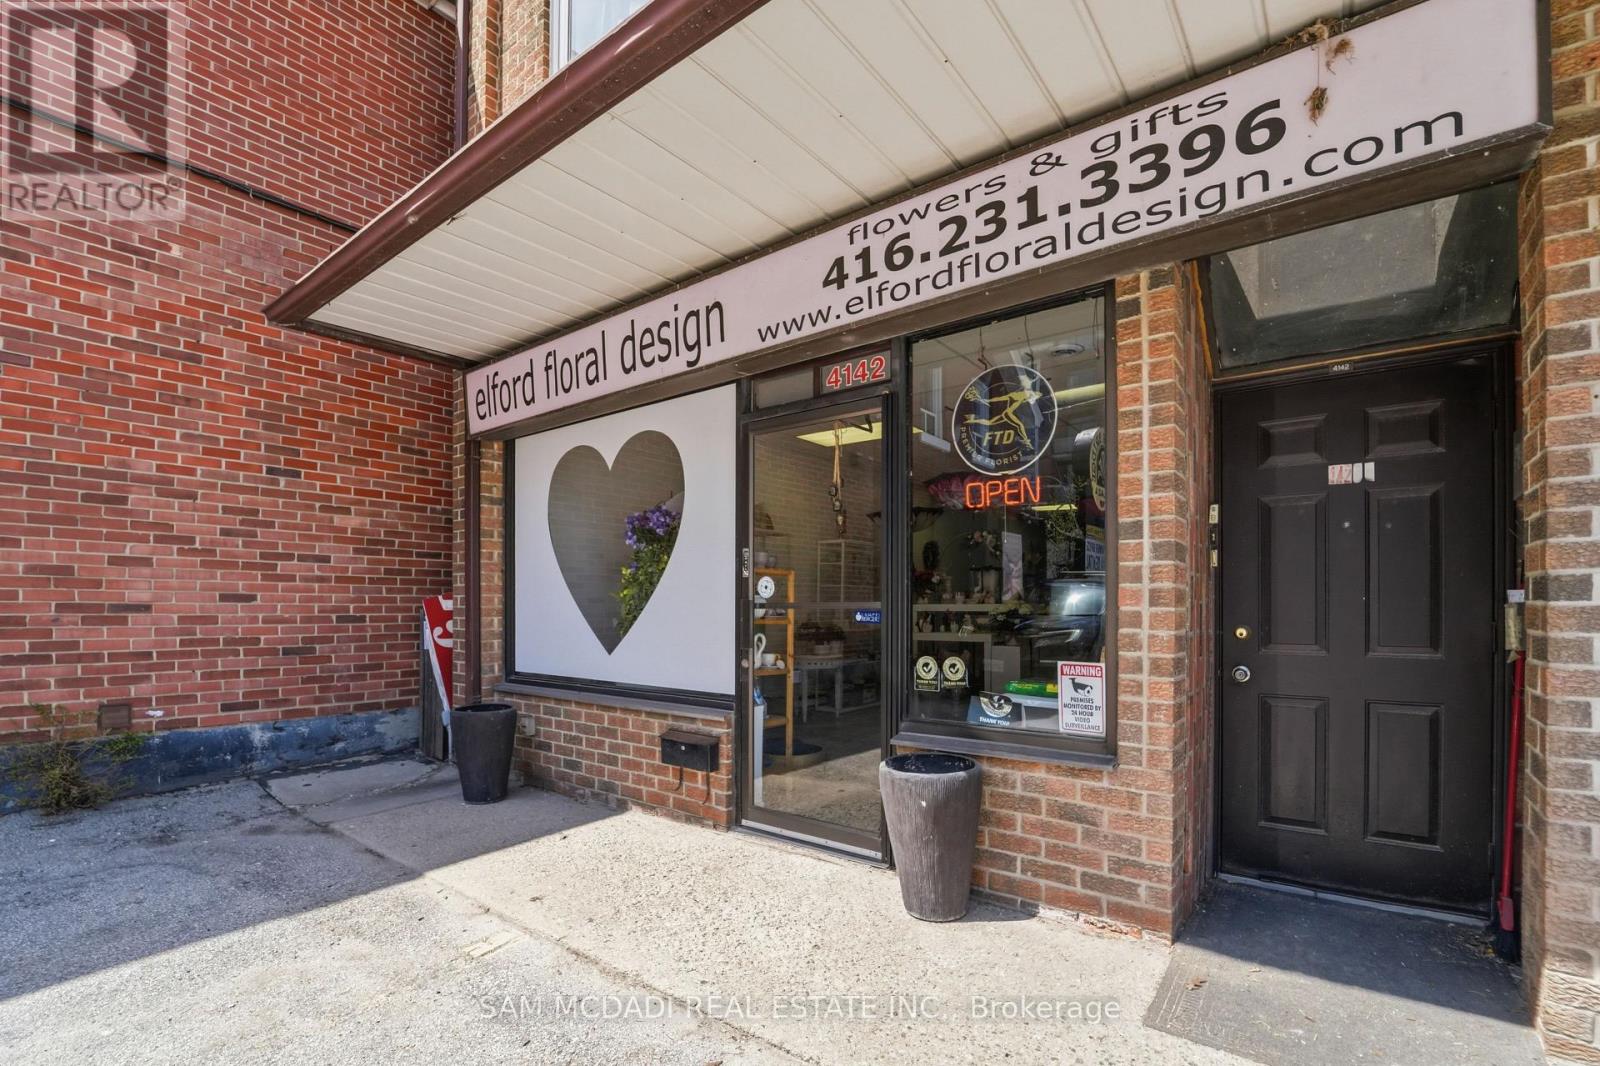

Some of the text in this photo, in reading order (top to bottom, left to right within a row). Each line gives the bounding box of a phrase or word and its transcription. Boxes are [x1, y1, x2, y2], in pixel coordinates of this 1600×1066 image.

[847, 91, 1229, 245] flowers & gifts
[822, 98, 1287, 290] 416.231.3396
[757, 111, 1463, 342] www.elfordfloraldesign.com
[475, 300, 726, 421] elford floral design
[826, 355, 886, 389] 4142
[1332, 363, 1350, 371] 4142
[983, 429, 1015, 447] FTD
[965, 476, 1041, 509] OPEN
[1062, 665, 1102, 677] WARNING
[1063, 703, 1094, 711] MONITORED
